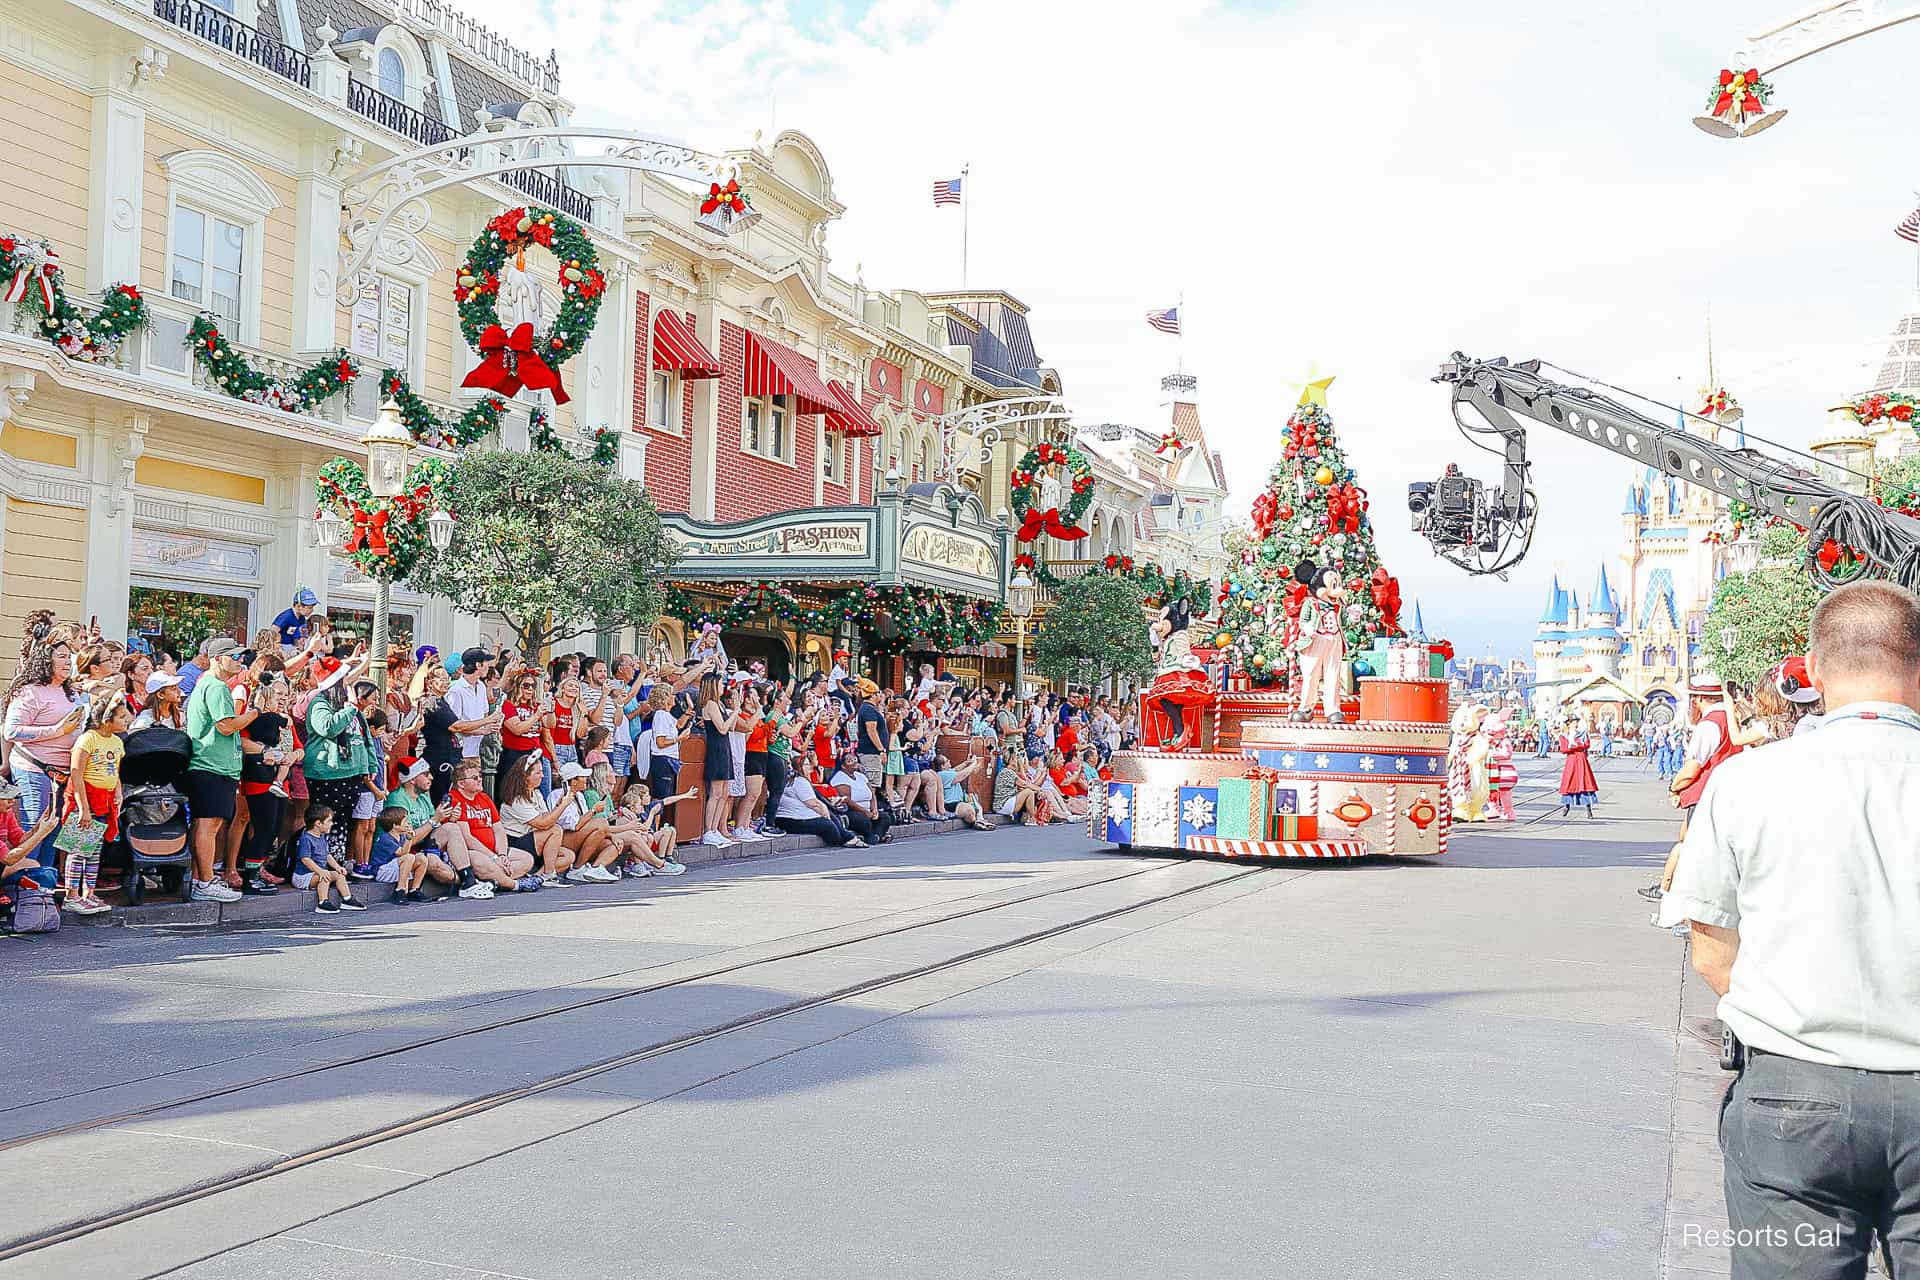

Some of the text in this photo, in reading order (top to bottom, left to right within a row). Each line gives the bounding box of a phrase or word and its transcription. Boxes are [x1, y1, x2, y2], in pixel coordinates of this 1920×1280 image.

[710, 534, 769, 554] Main Street
[781, 526, 861, 553] FASHION
